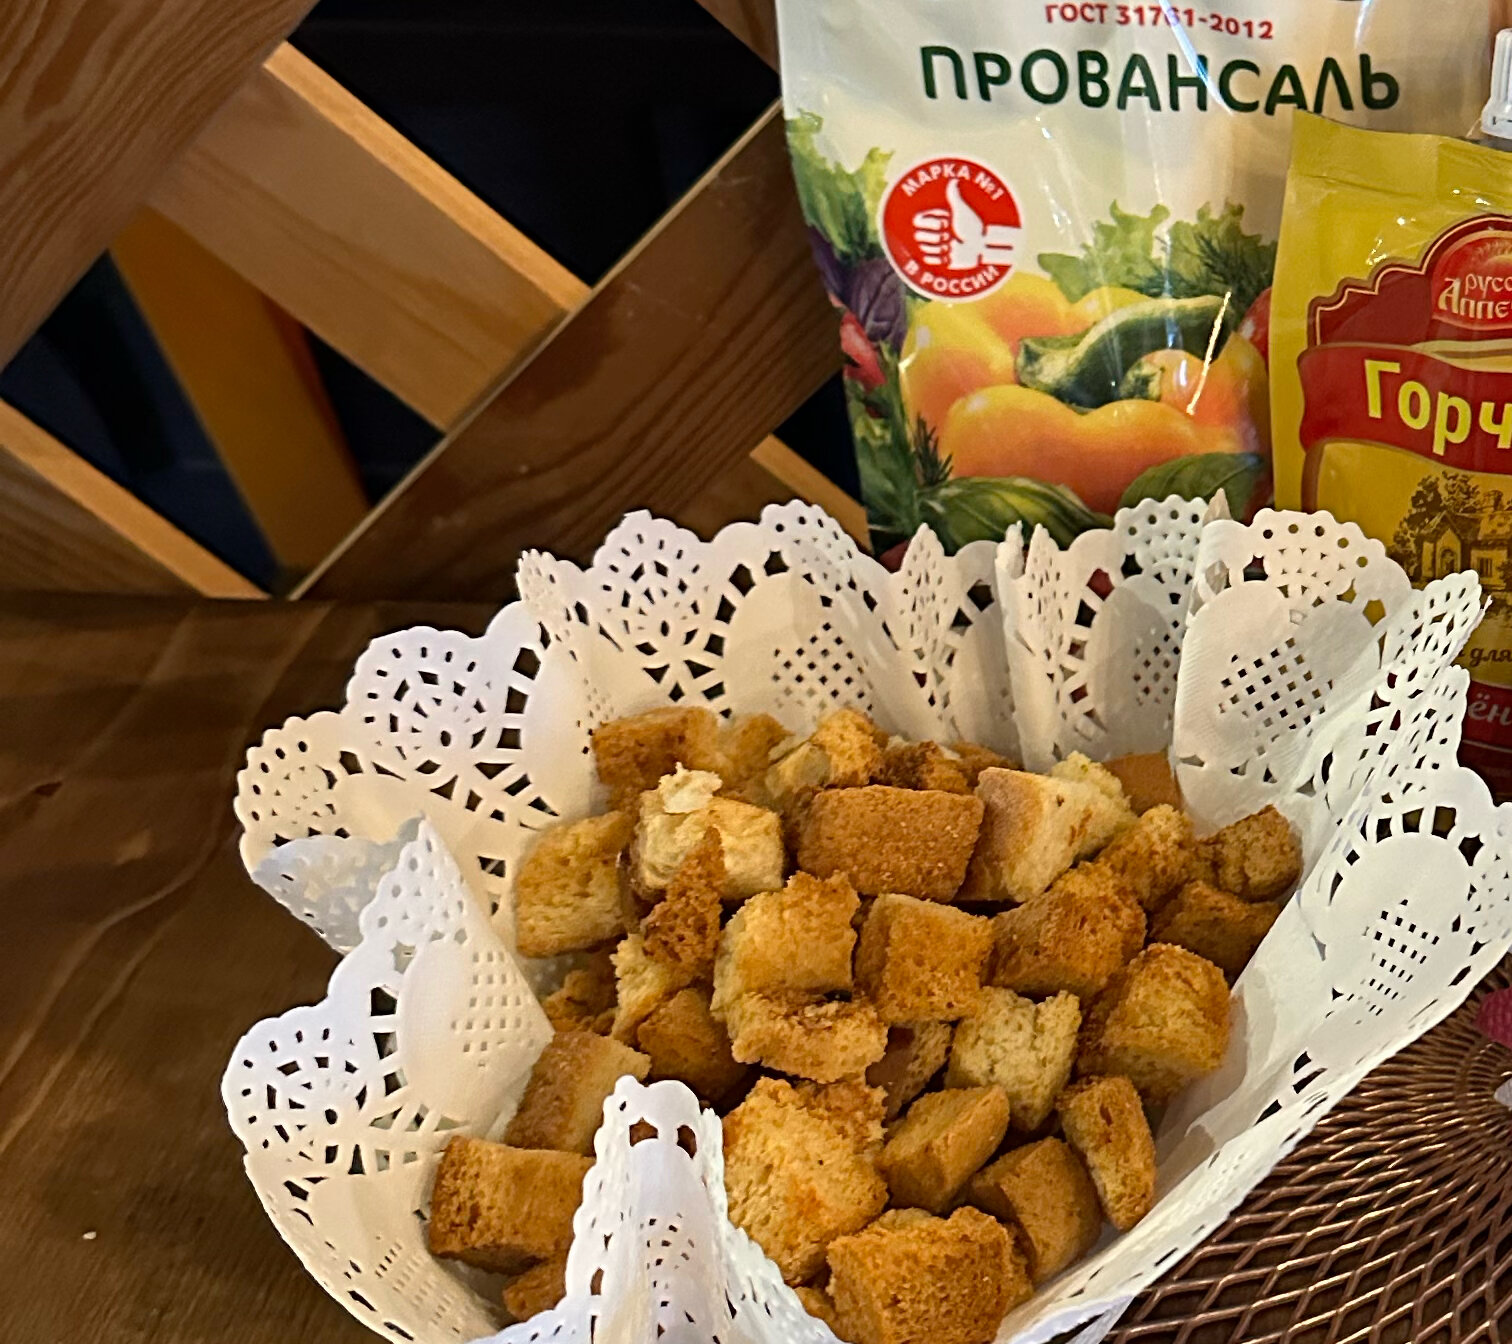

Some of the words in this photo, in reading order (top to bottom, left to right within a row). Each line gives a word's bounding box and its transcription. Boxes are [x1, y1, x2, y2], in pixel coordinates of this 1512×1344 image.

[1045, 3, 1106, 25] ГОСТ
[920, 45, 1400, 116] ПРОВАНСАЛЬ
[902, 163, 971, 197] МАРКА
[904, 259, 920, 277] В
[920, 266, 999, 293] РОССИИ
